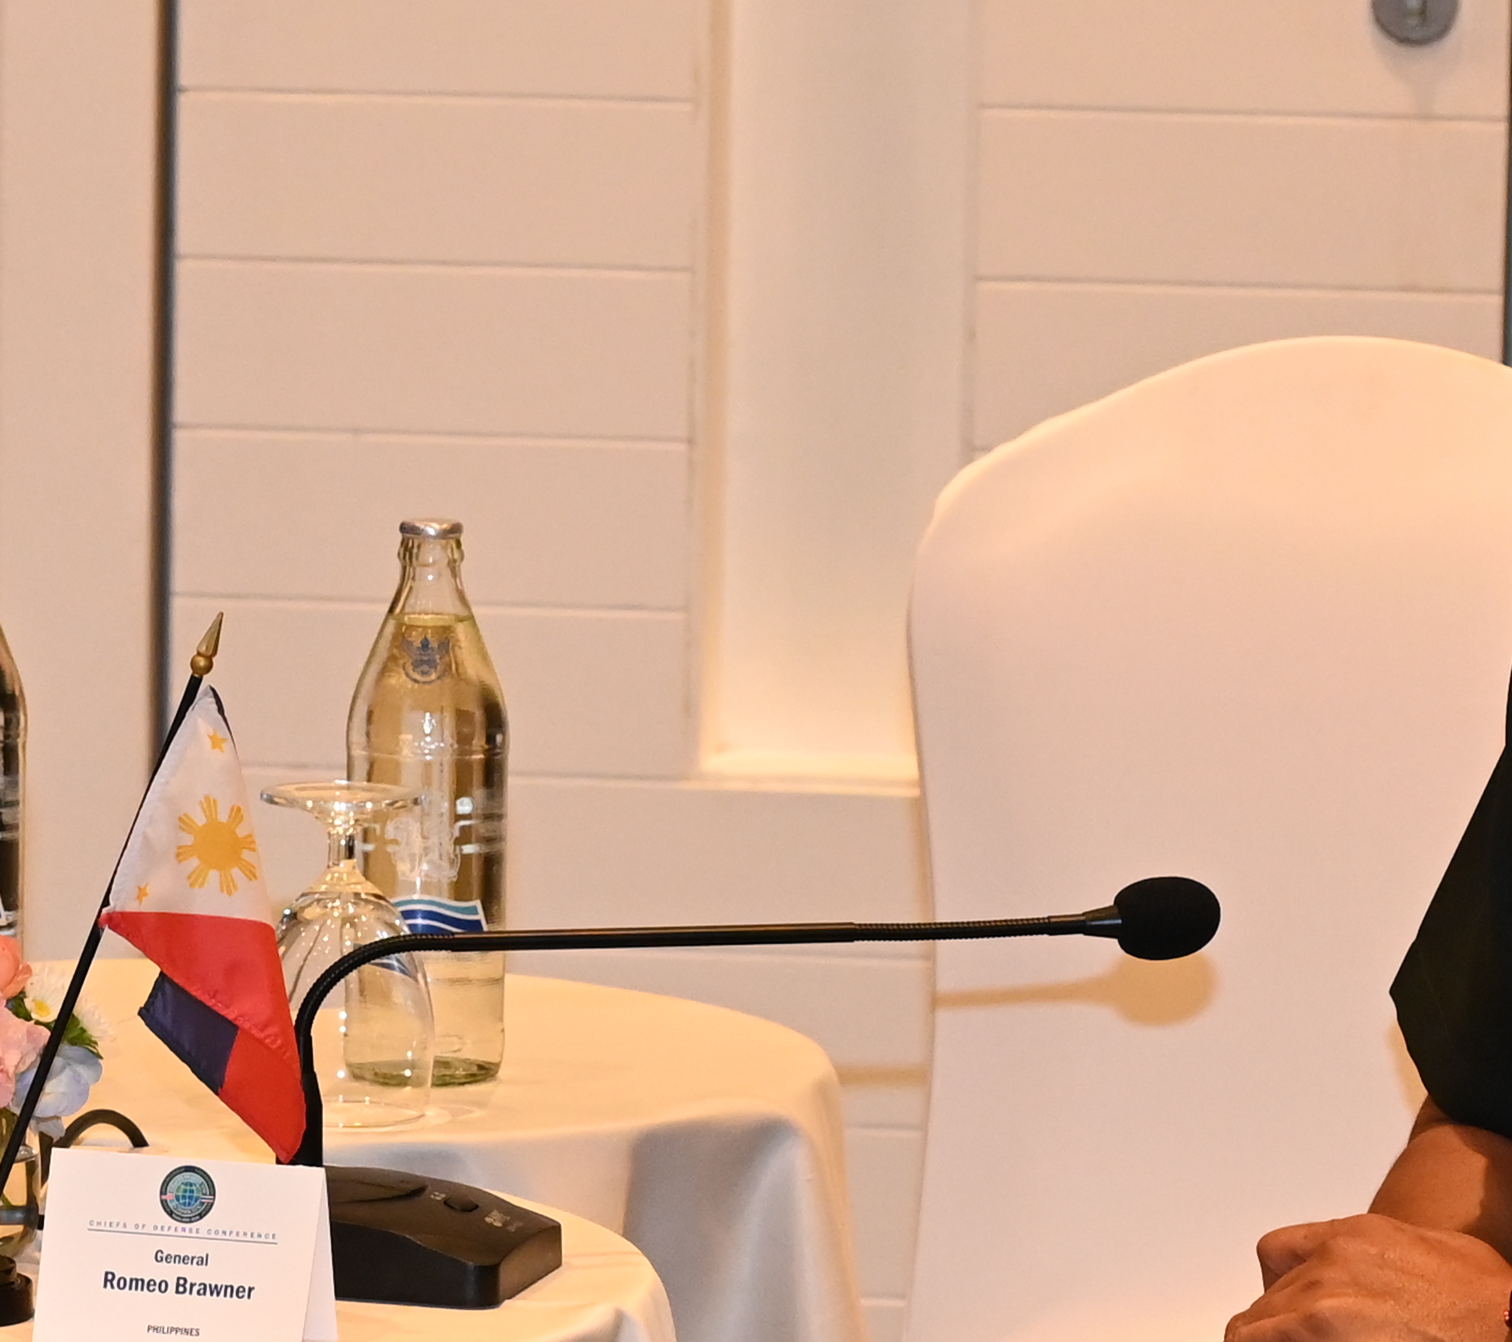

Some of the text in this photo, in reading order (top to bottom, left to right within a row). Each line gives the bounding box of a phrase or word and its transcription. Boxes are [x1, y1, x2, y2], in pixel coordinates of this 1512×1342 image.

[89, 1220, 128, 1229] CHIEFS
[152, 1224, 201, 1235] DEFENSE
[206, 1228, 278, 1240] CONFERENCE
[154, 1249, 210, 1267] General
[102, 1270, 256, 1300] Romeo Brawner
[146, 1324, 200, 1337] PHILIPPINES
